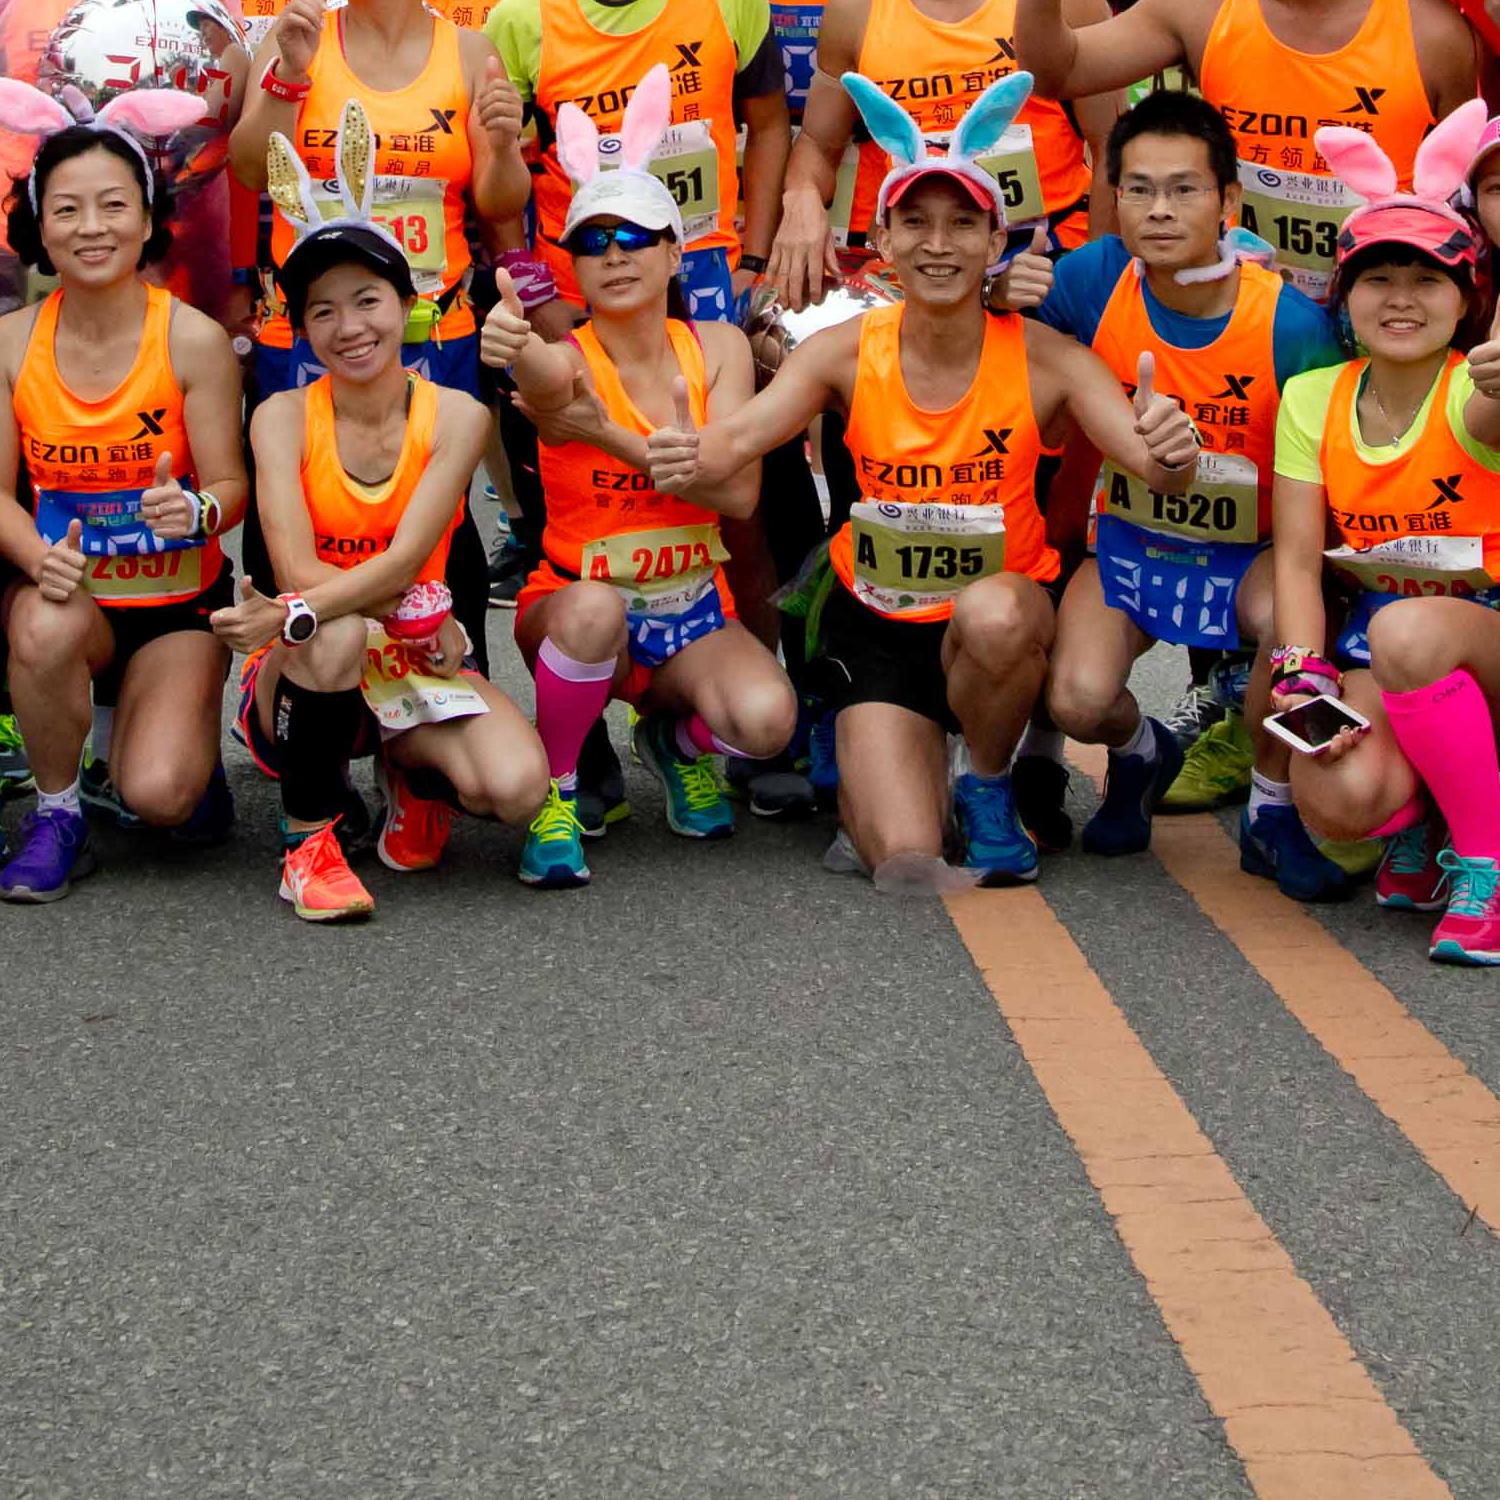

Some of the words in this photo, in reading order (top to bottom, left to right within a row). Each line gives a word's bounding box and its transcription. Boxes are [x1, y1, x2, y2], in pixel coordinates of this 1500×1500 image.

[135, 36, 179, 51] EZON
[1221, 107, 1308, 138] EZON
[303, 129, 381, 150] EZN
[389, 134, 436, 153] 宜准
[1273, 213, 1338, 257] 153
[1193, 402, 1250, 427] 宜准
[30, 443, 99, 465] EZON
[106, 441, 155, 463] 宜准
[591, 468, 655, 493] EZO
[860, 454, 943, 489] EZON
[950, 458, 1006, 486] 宜准
[1110, 471, 1131, 510] A
[1147, 490, 1237, 533] 1520
[1403, 510, 1453, 533] 宜准
[589, 552, 612, 583] A
[857, 533, 878, 570] A
[894, 544, 984, 580] 1735
